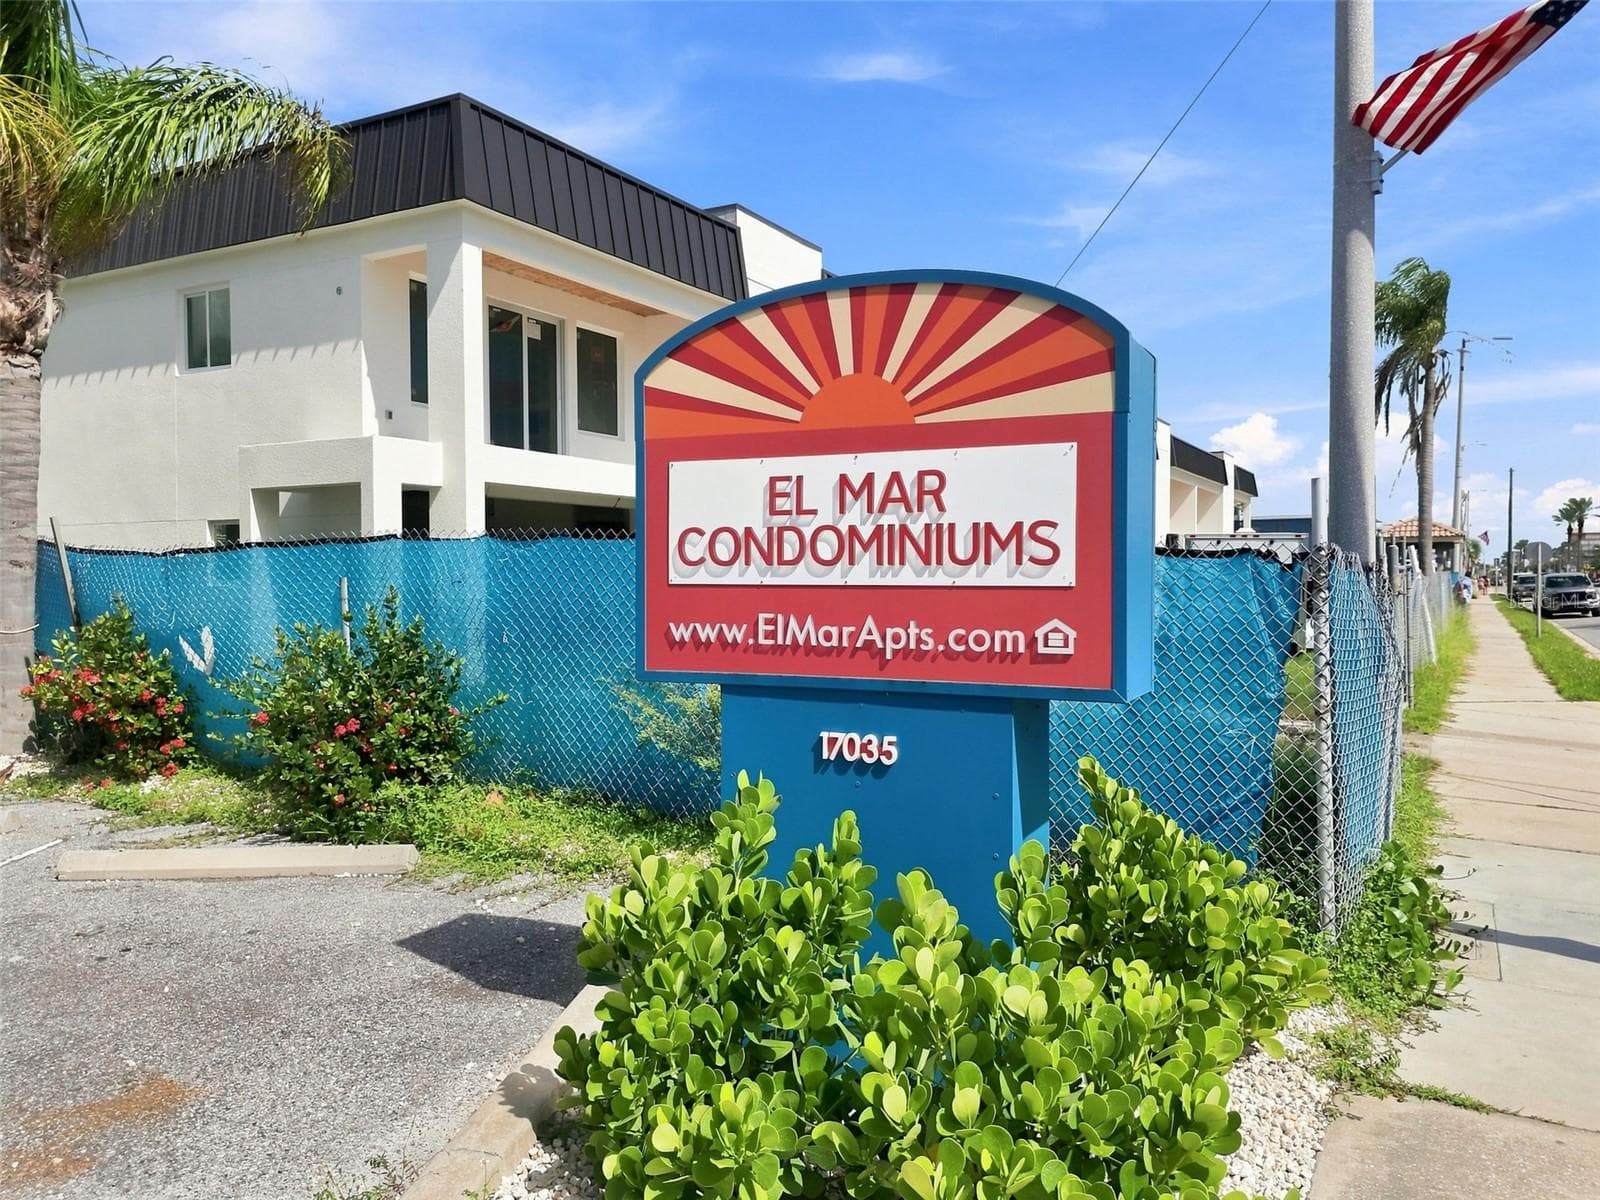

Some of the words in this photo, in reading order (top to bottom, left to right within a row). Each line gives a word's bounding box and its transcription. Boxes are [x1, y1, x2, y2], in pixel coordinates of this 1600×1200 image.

[769, 475, 817, 516] EL
[838, 469, 947, 514] MAR
[677, 519, 1060, 567] CONDOMINIUMS
[668, 613, 1026, 659] www.ElMarApts.com
[820, 731, 898, 766] 17035
